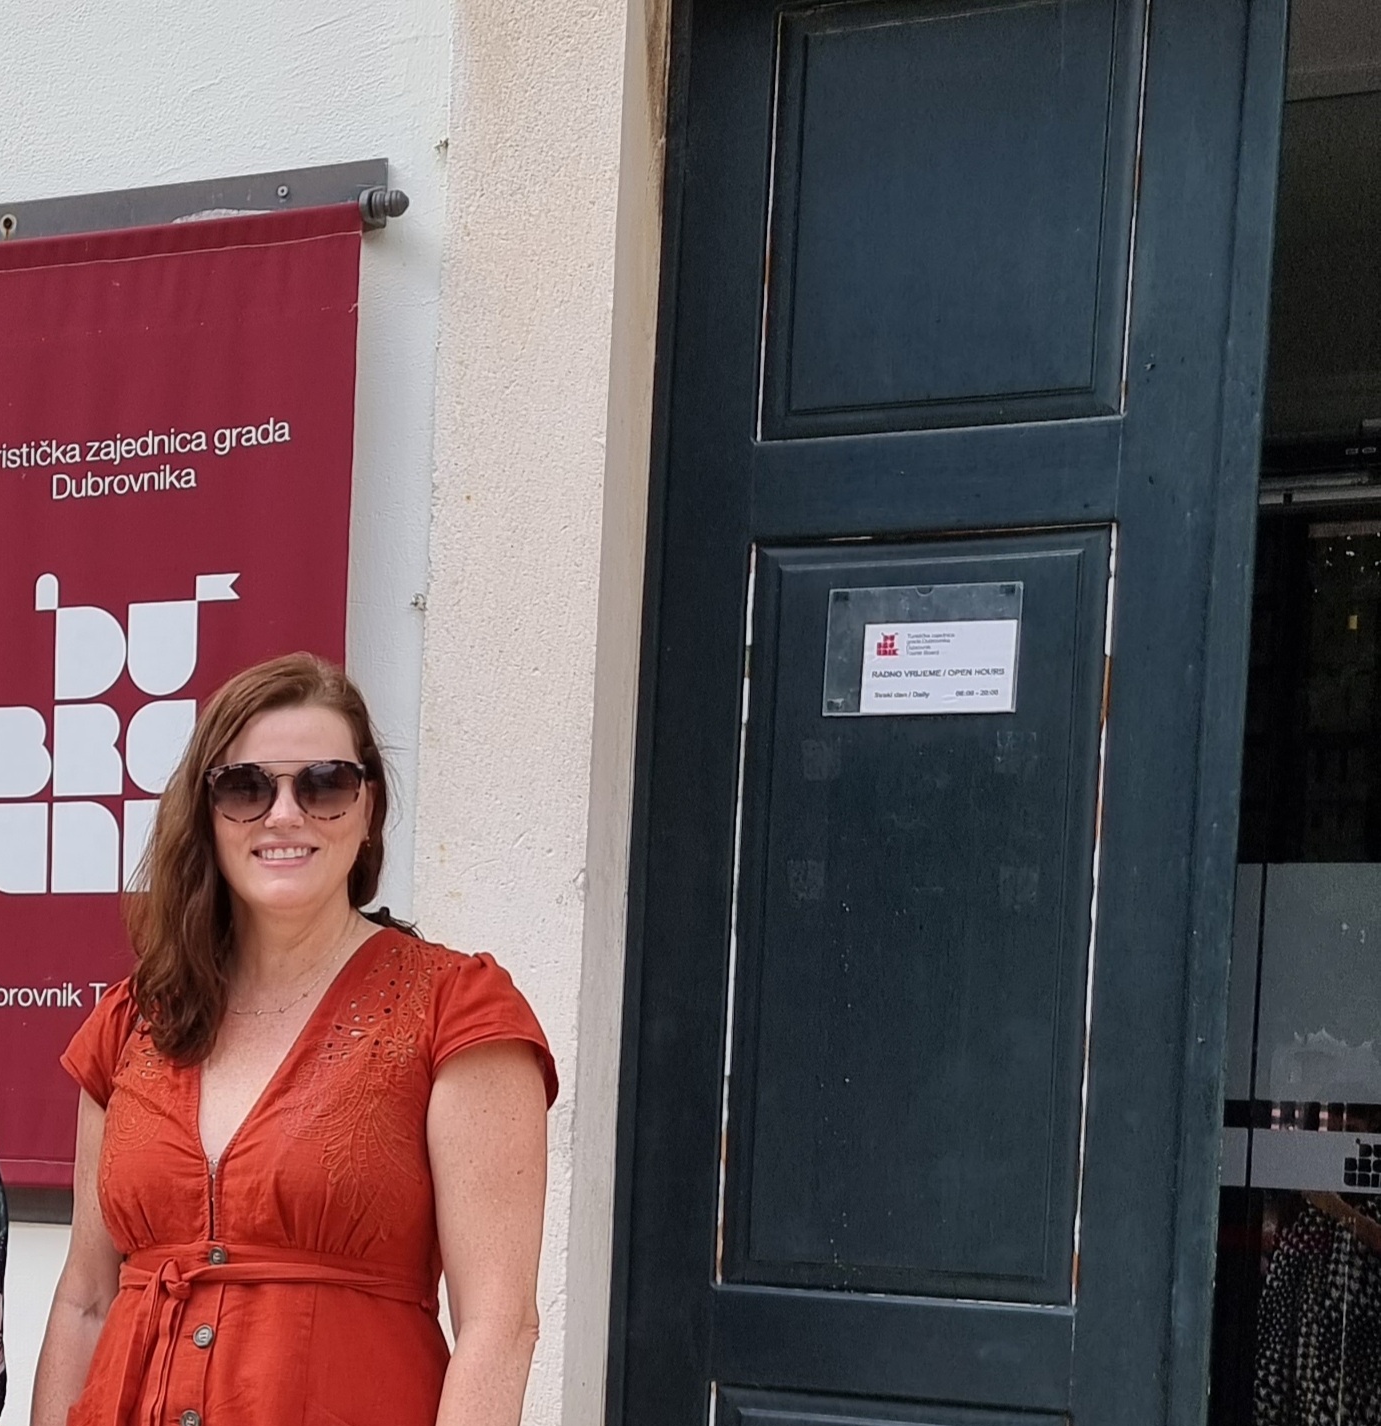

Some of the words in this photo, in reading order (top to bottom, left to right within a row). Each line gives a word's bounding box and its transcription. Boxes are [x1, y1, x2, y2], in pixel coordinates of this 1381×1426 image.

[86, 429, 207, 464] zajednica
[214, 418, 291, 455] grada
[52, 465, 197, 500] Dubrovnika
[872, 670, 902, 678] RADNO
[905, 669, 941, 678] VRIJEME
[948, 668, 972, 676] OPEN
[974, 667, 1005, 676] HOURS
[913, 691, 930, 699] Daily
